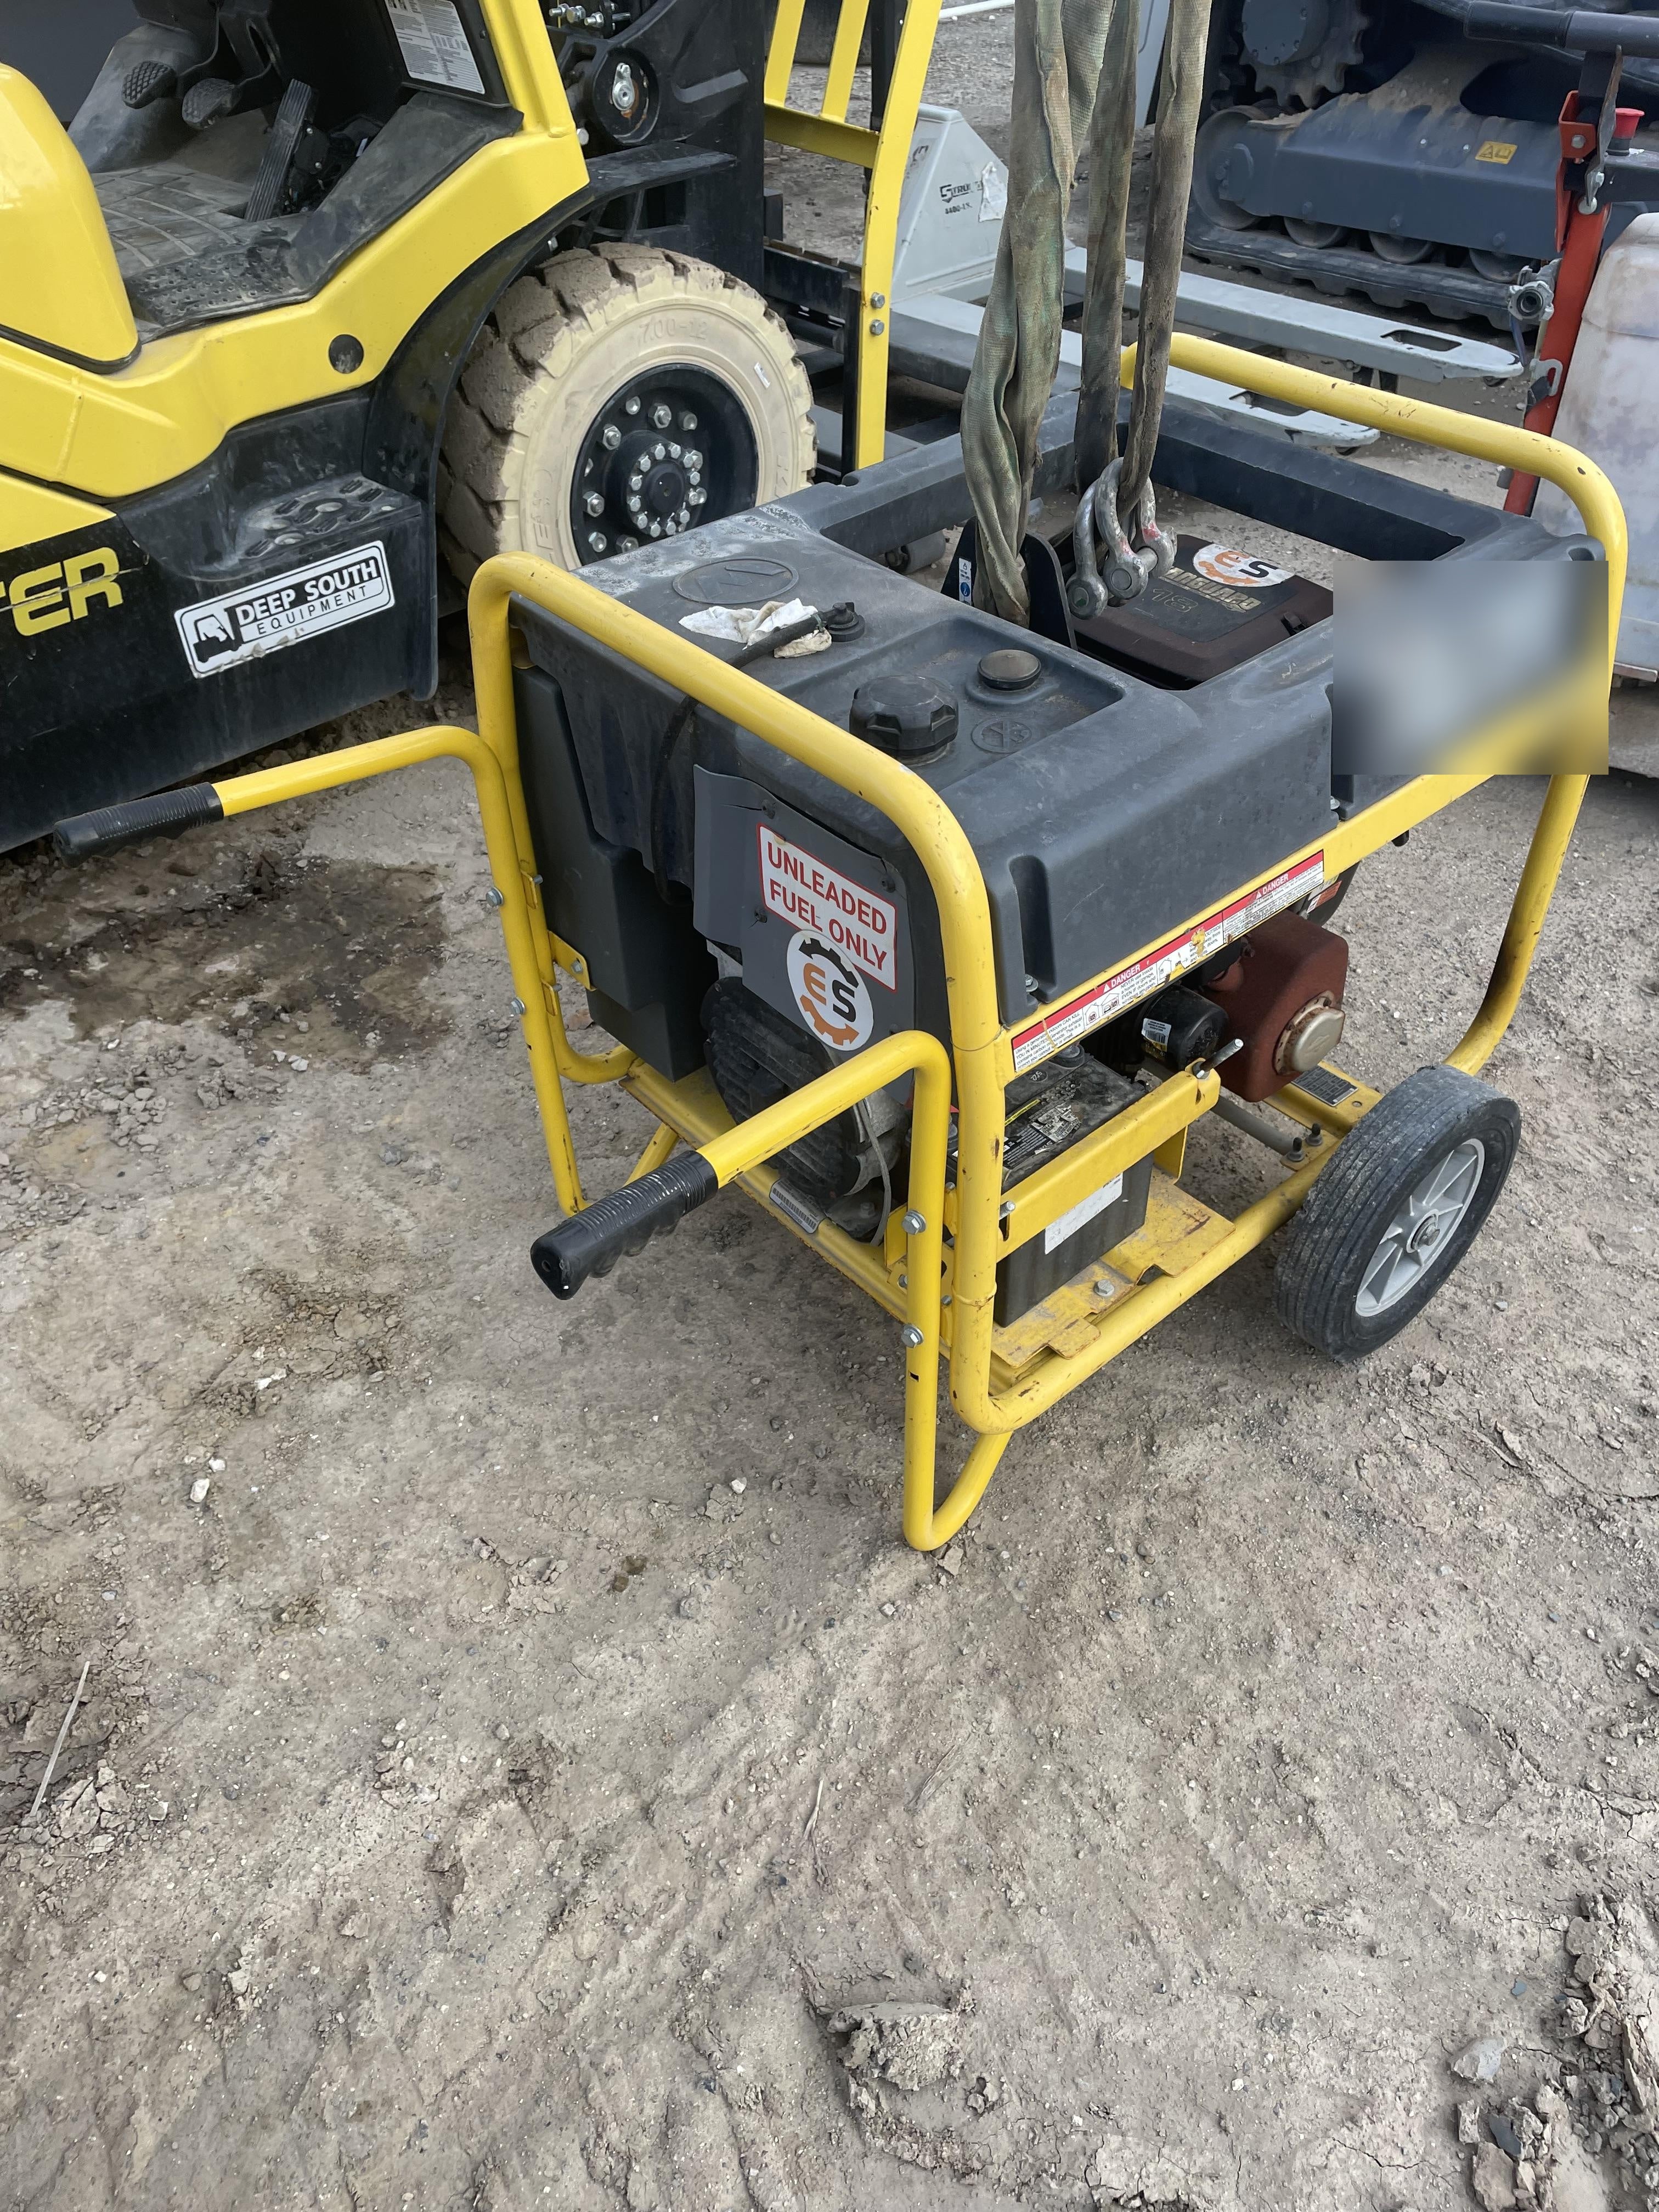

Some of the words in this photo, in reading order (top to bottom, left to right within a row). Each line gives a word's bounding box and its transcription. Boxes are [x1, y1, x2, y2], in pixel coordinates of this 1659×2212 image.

[0, 547, 123, 636] ER
[236, 589, 296, 626] DEEP
[304, 559, 379, 601] SOUTH
[257, 584, 368, 635] EQUIPMENT
[1152, 588, 1199, 613] 18
[1164, 567, 1262, 611] ANGUARD
[768, 842, 887, 935] UNLEADED
[1262, 873, 1289, 895] DANGER
[770, 878, 823, 932] FUEL
[829, 918, 887, 971] ONLY
[803, 962, 856, 1023] ES
[1110, 964, 1141, 988] DANGER
[1121, 978, 1134, 989] NEVER
[1121, 990, 1132, 999] EVEN
[1015, 1046, 1026, 1054] Using
